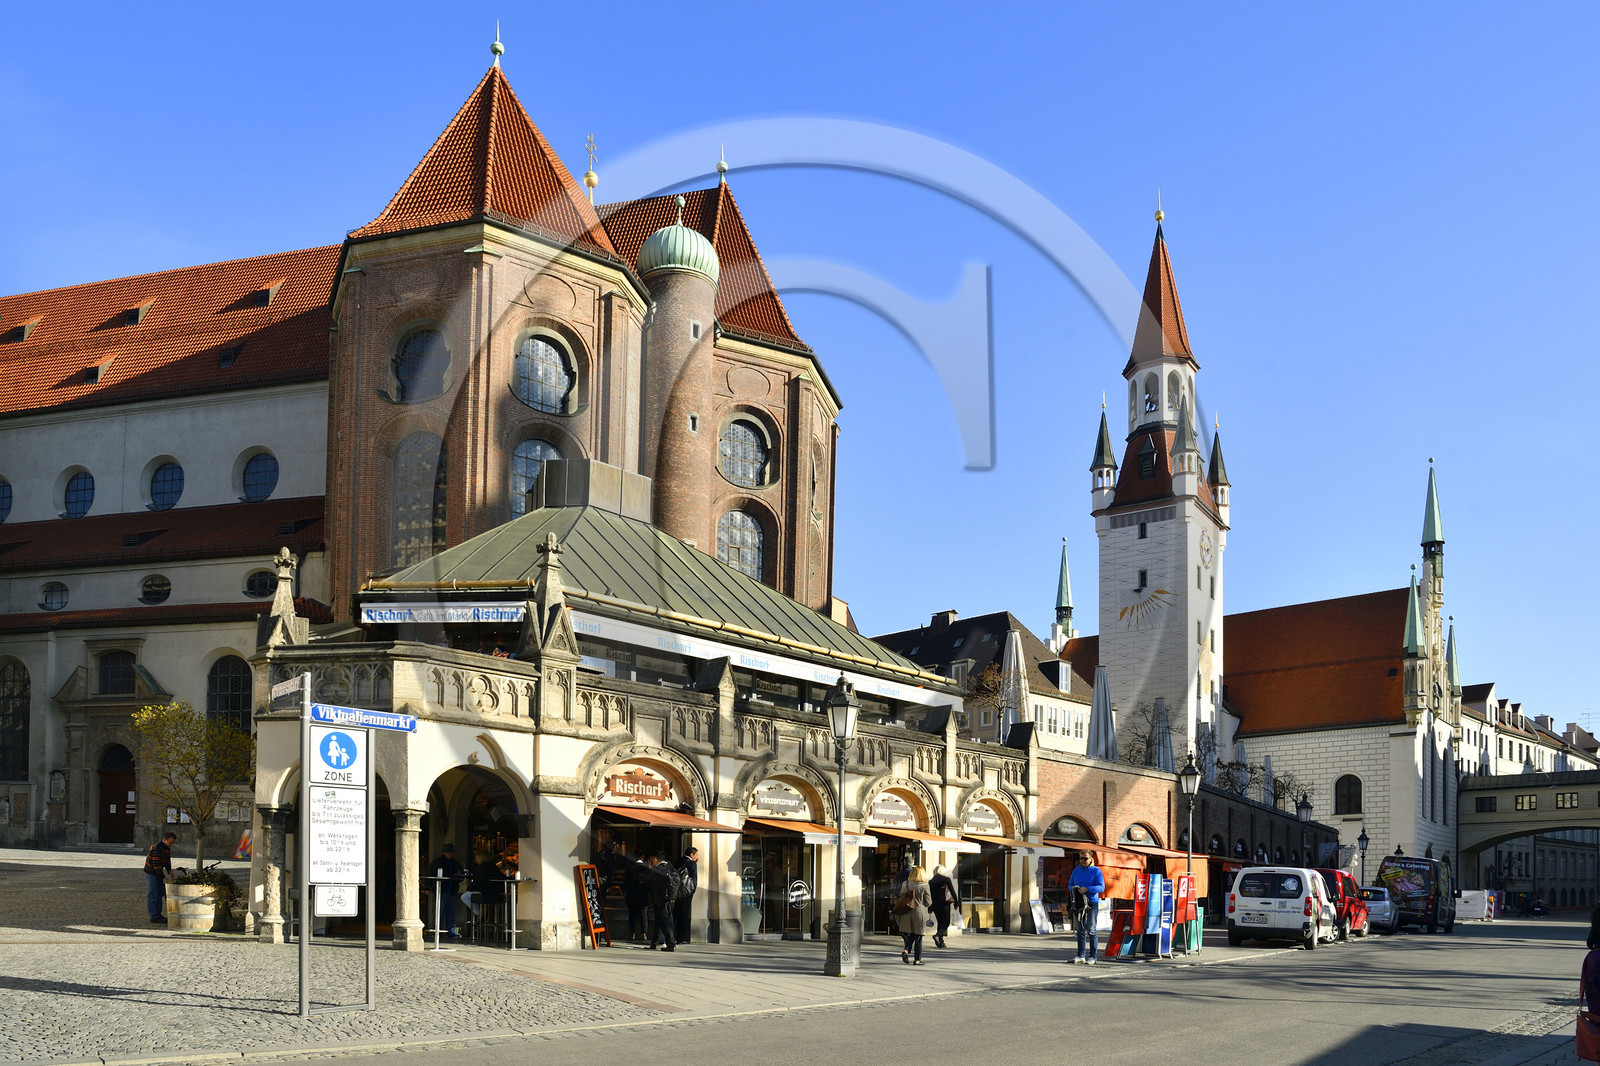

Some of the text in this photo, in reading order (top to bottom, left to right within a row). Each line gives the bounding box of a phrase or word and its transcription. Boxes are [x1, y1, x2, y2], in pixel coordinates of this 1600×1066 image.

[366, 609, 413, 621] Rischart
[473, 608, 520, 621] Rischart
[573, 620, 602, 634] schart
[657, 636, 692, 653] Rischart
[740, 654, 770, 670] Rischart
[756, 679, 783, 693] Rischart
[876, 684, 900, 697] Rischart
[317, 706, 413, 729] Viktualienmarkt
[324, 771, 352, 782] ZONE
[616, 778, 663, 797] Rischart
[760, 795, 800, 807] vinzenzmurr
[1406, 863, 1430, 871] Catering
